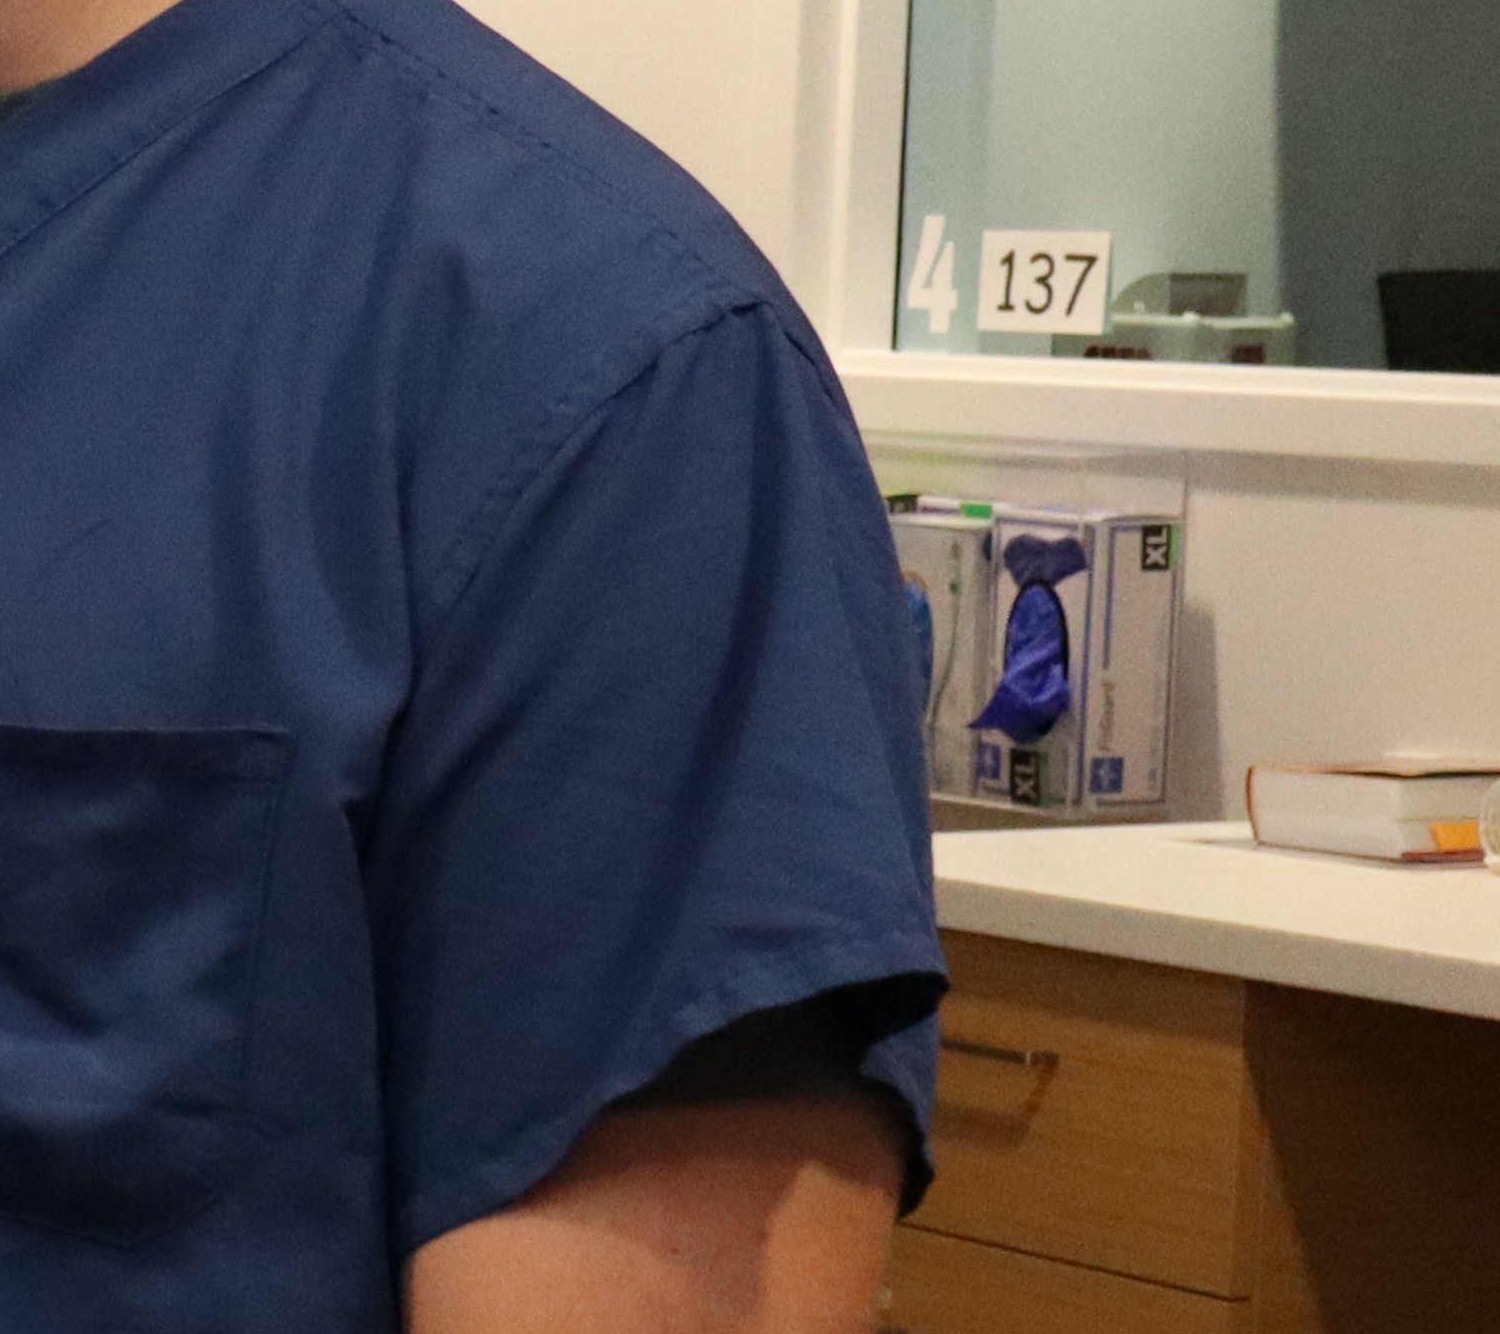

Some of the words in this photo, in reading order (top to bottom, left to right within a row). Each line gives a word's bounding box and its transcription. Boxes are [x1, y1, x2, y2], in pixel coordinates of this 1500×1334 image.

[907, 214, 958, 333] 4
[997, 248, 1099, 317] 137
[1146, 525, 1169, 565] XL
[1014, 754, 1038, 801] XL
